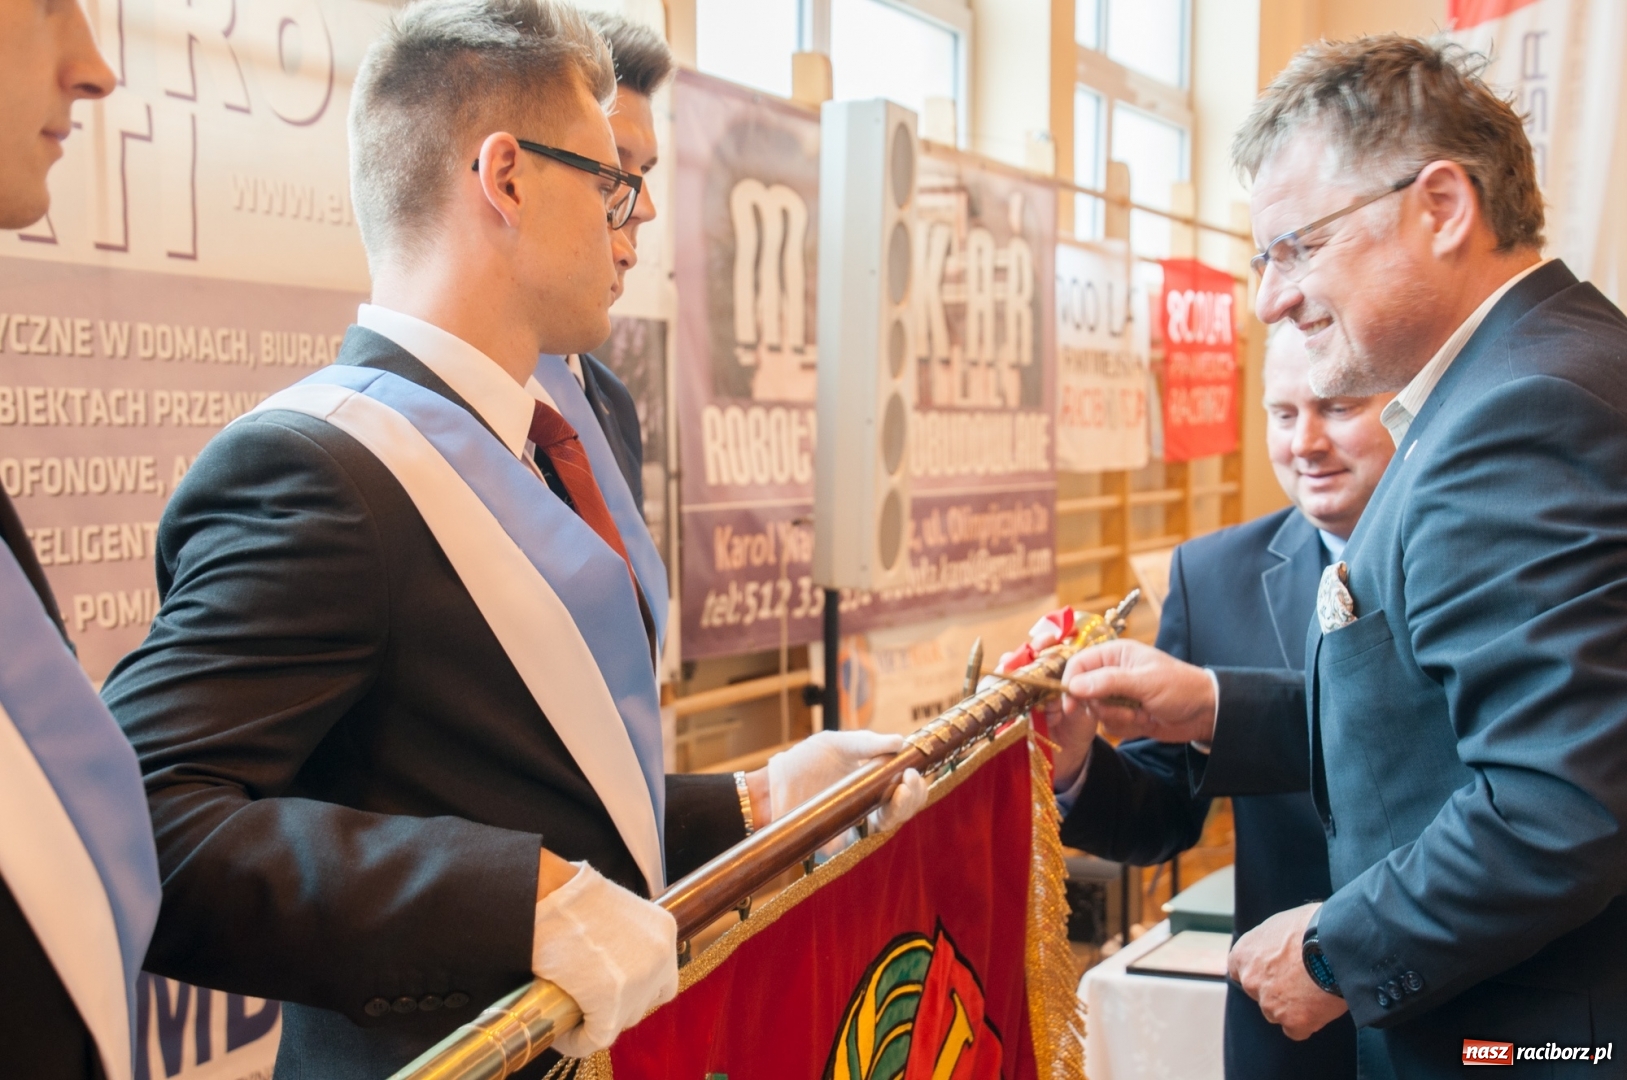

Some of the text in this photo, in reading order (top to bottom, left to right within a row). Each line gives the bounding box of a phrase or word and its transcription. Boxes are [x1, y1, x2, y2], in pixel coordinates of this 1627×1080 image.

[100, 320, 132, 359] W
[138, 322, 257, 369] DOMACH,
[154, 389, 268, 428] PRZEMY
[26, 522, 158, 567] ELIGENT
[713, 521, 776, 572] Karol
[74, 589, 161, 633] POMI
